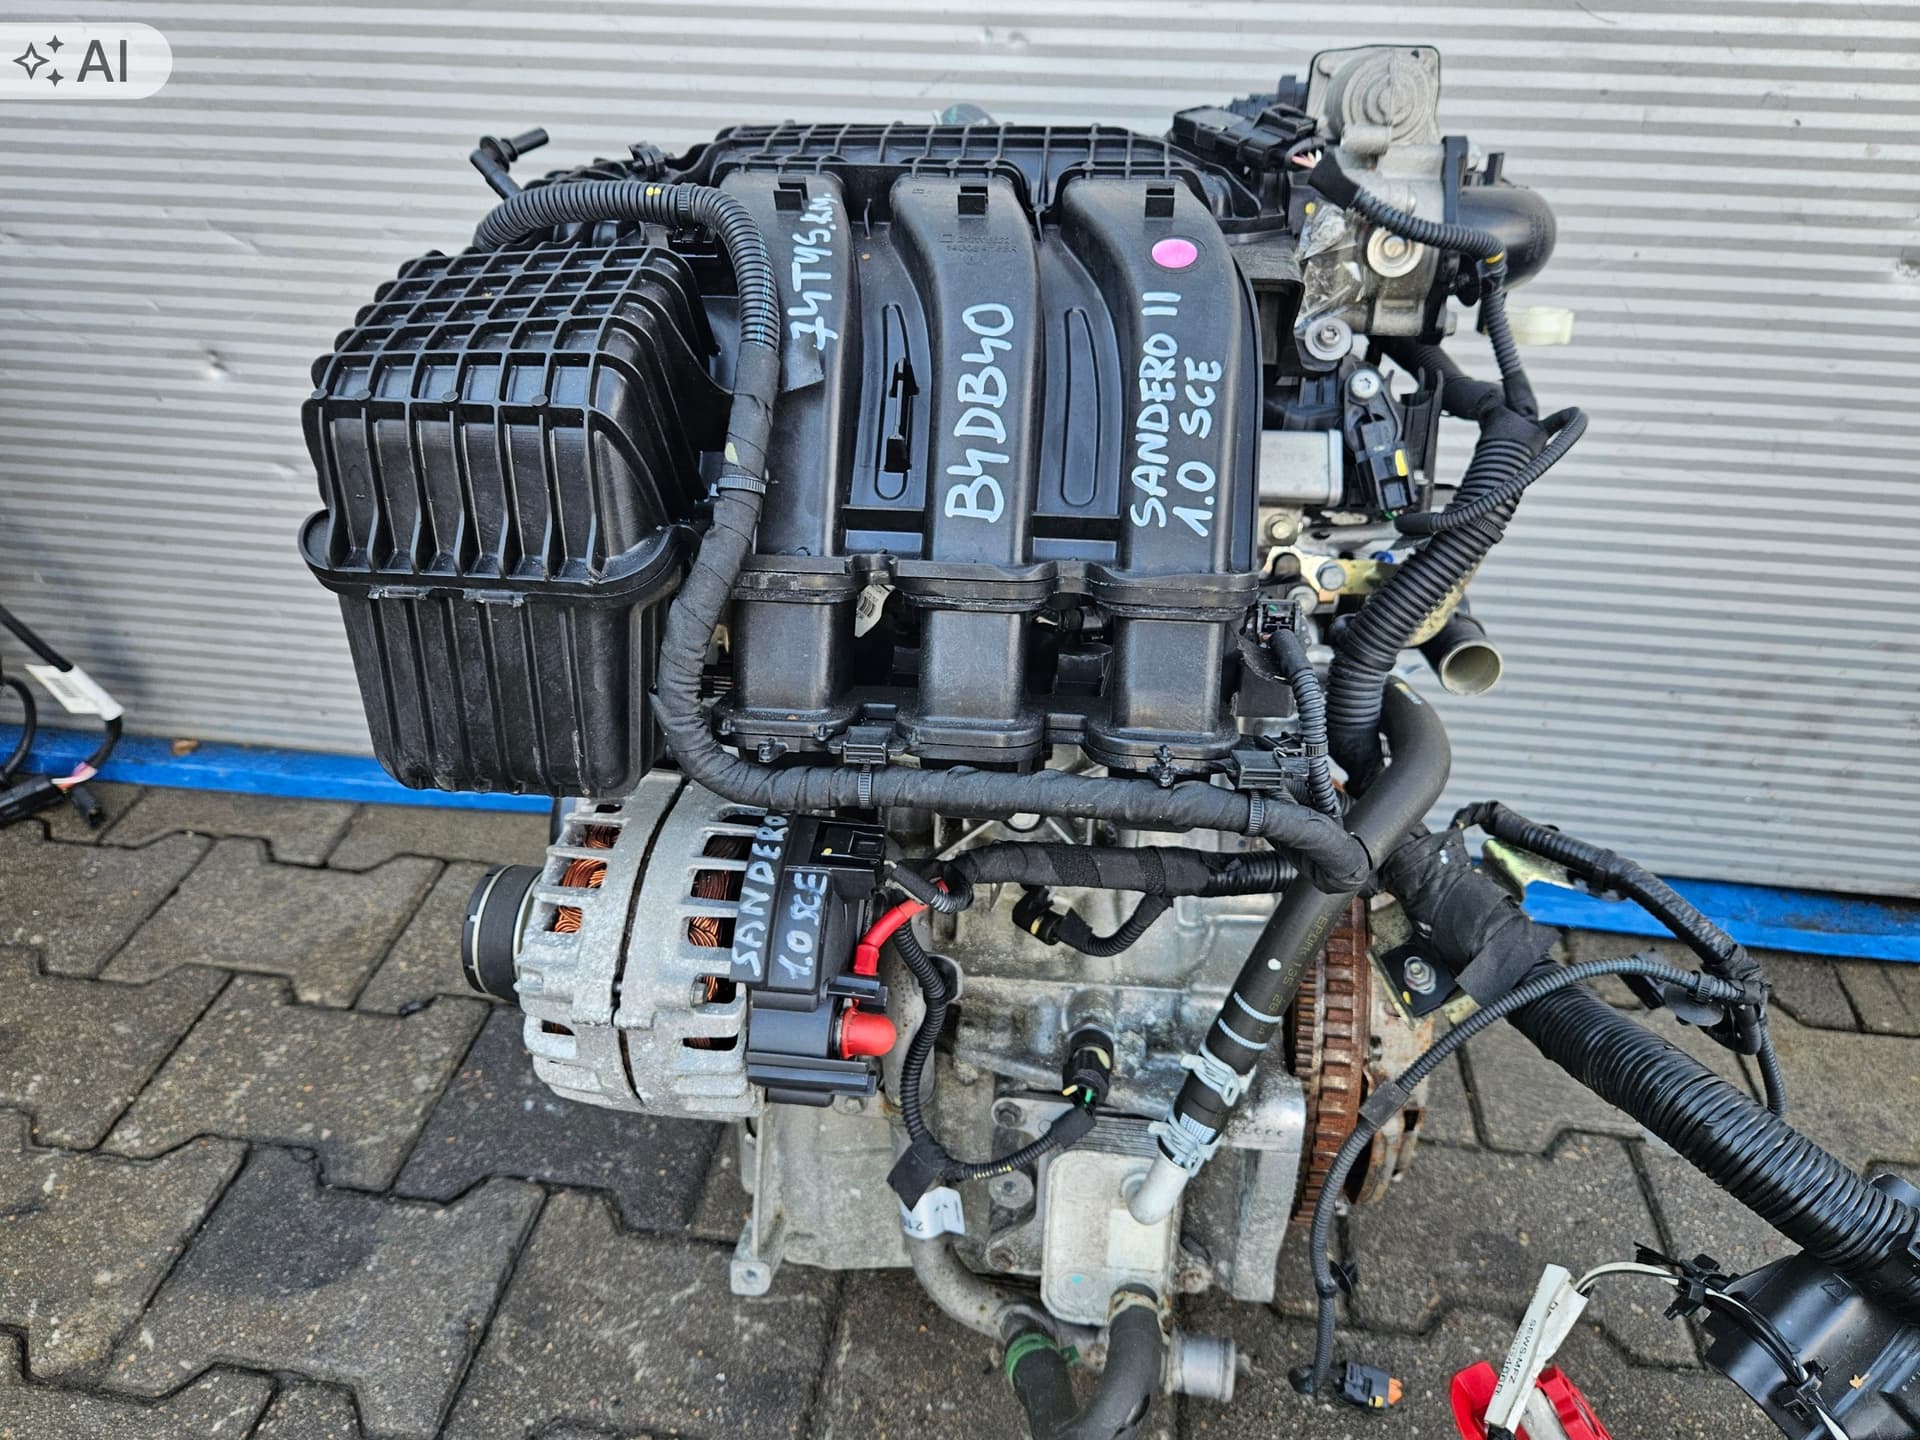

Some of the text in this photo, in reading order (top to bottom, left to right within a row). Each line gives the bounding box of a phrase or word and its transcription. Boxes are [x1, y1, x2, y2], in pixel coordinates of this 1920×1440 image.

[1130, 333, 1178, 528] SANDERO
[1172, 356, 1223, 537] 1.0 SCE
[731, 815, 789, 977] SANDERO
[777, 872, 828, 980] 1.0 SCE
